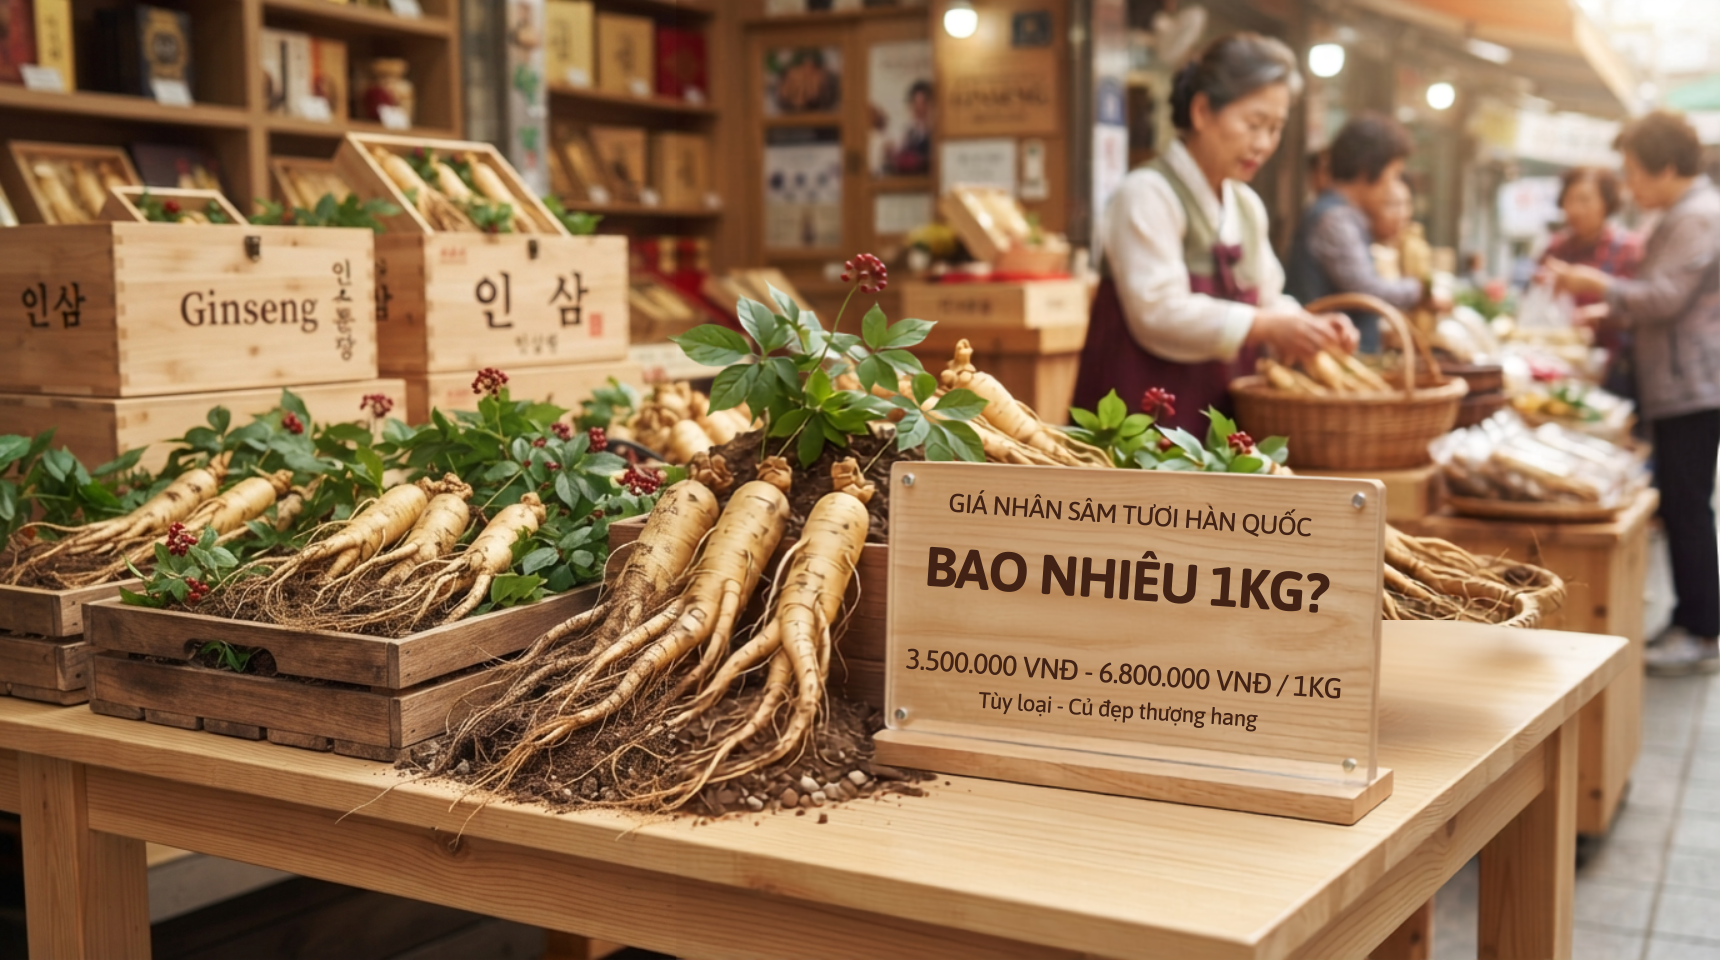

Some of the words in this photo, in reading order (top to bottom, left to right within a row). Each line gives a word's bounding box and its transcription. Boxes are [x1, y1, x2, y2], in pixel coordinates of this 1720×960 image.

[22, 282, 86, 329] 인삼
[180, 289, 319, 333] Ginseng
[949, 489, 988, 515] GIÁ
[993, 493, 1062, 520] NHÂN
[1068, 497, 1117, 524] SÂM
[1122, 503, 1178, 528] TƯƠI
[1185, 503, 1236, 532] HÀN
[1242, 508, 1312, 537] QUỐC
[927, 546, 1028, 593] BAO
[1041, 550, 1198, 604] NHIÊU
[1210, 566, 1330, 614] 1KG?
[905, 648, 1017, 677] 3.500.000
[1023, 656, 1078, 681] VNĐ
[1099, 662, 1210, 690] 6.800.000
[1216, 669, 1272, 694] VNĐ
[1293, 675, 1341, 699] 1KG
[978, 691, 1013, 715] Tùy
[1017, 693, 1052, 717] loại
[1068, 698, 1093, 716] Củ
[1098, 699, 1134, 723] đẹp
[1139, 702, 1207, 729] thượng
[1211, 706, 1259, 732] hang
